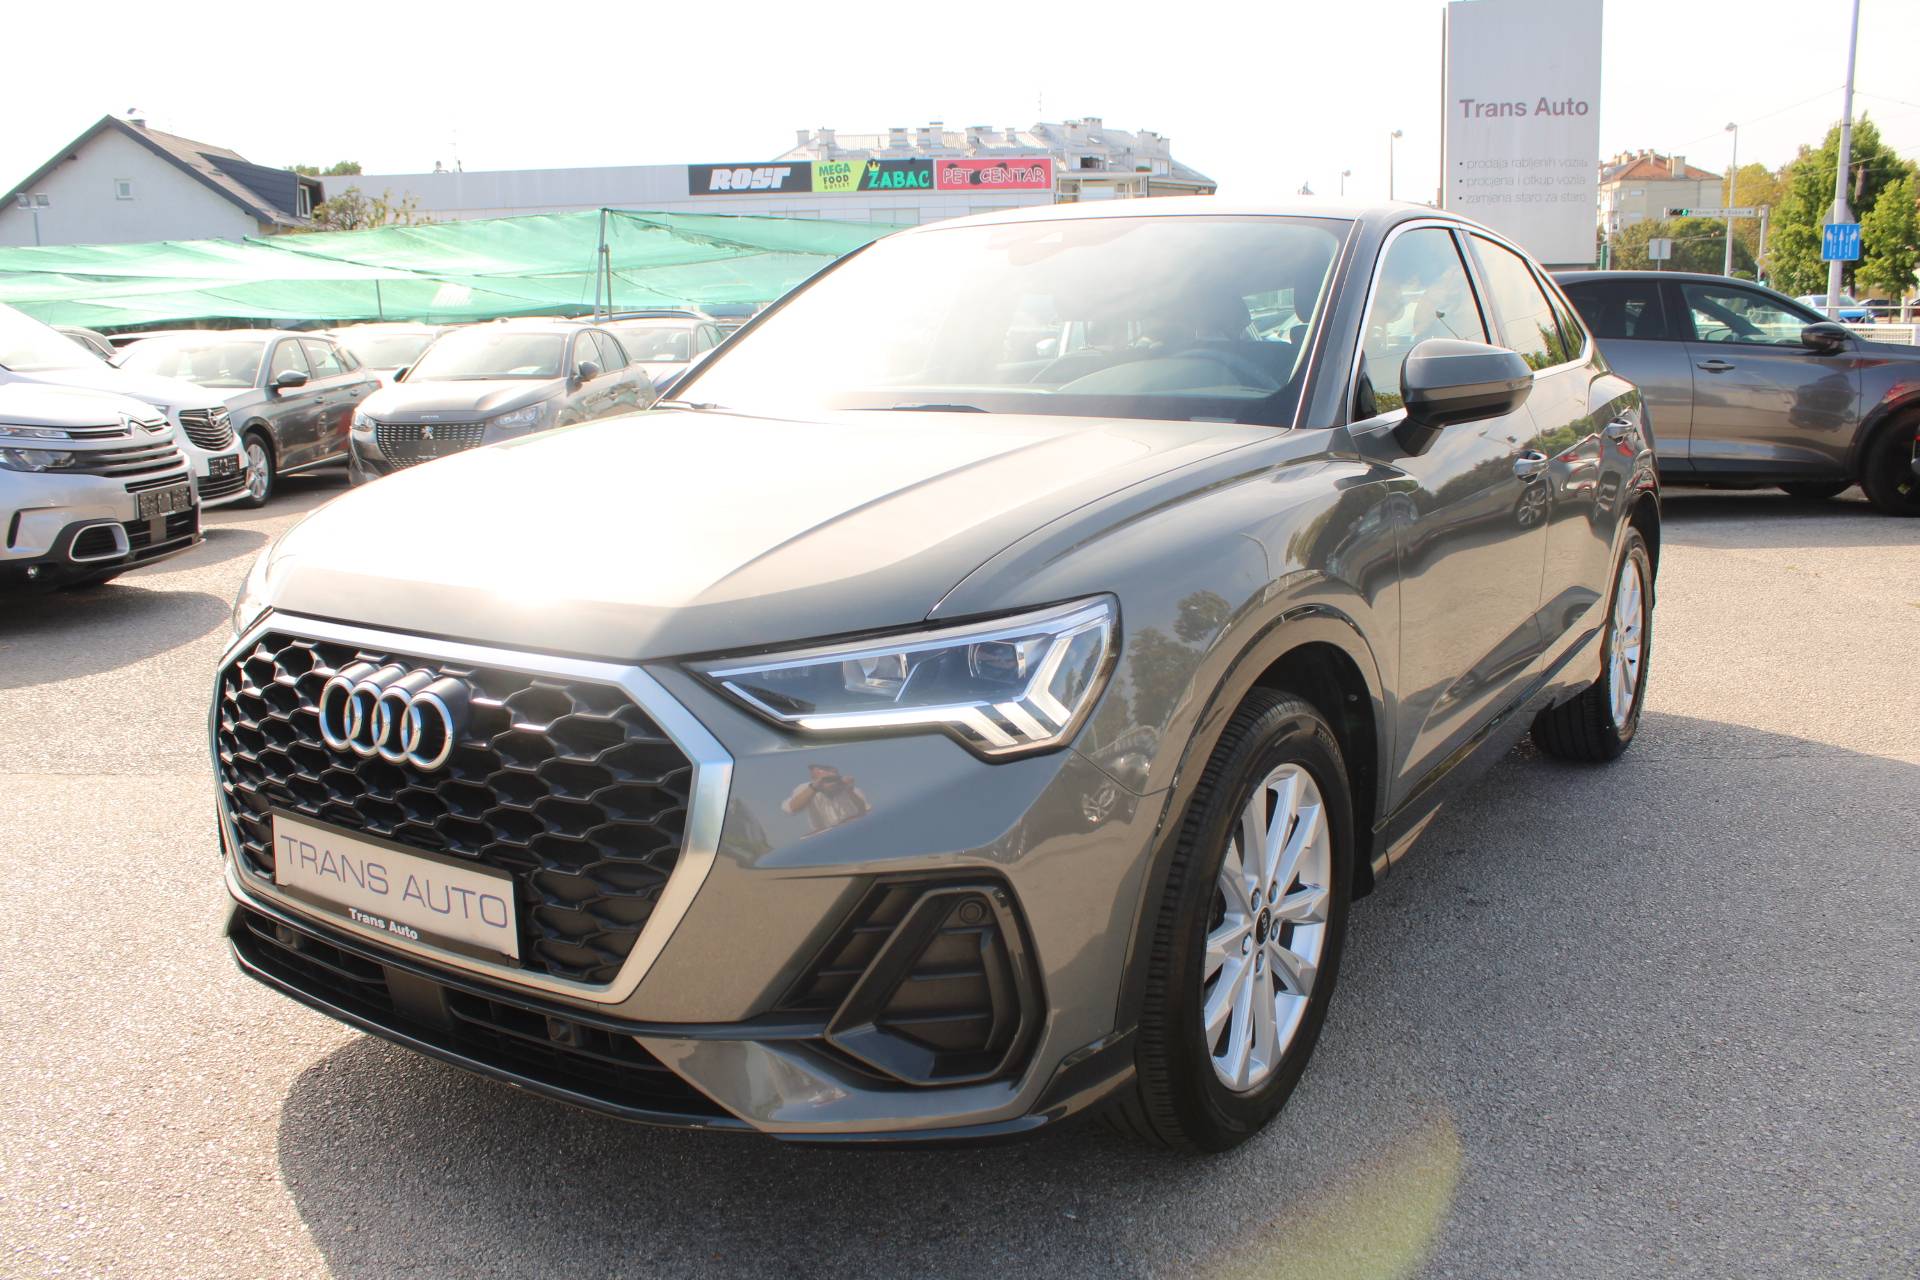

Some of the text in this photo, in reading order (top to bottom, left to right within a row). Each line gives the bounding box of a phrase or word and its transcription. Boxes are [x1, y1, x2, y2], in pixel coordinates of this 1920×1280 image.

[1459, 97, 1589, 118] Trans Auto
[819, 163, 852, 177] MEGA
[823, 174, 849, 184] FOOD
[943, 166, 1046, 185] PET CENTAR
[280, 835, 508, 929] TRANS AUTO
[349, 908, 418, 940] Trans Auto
